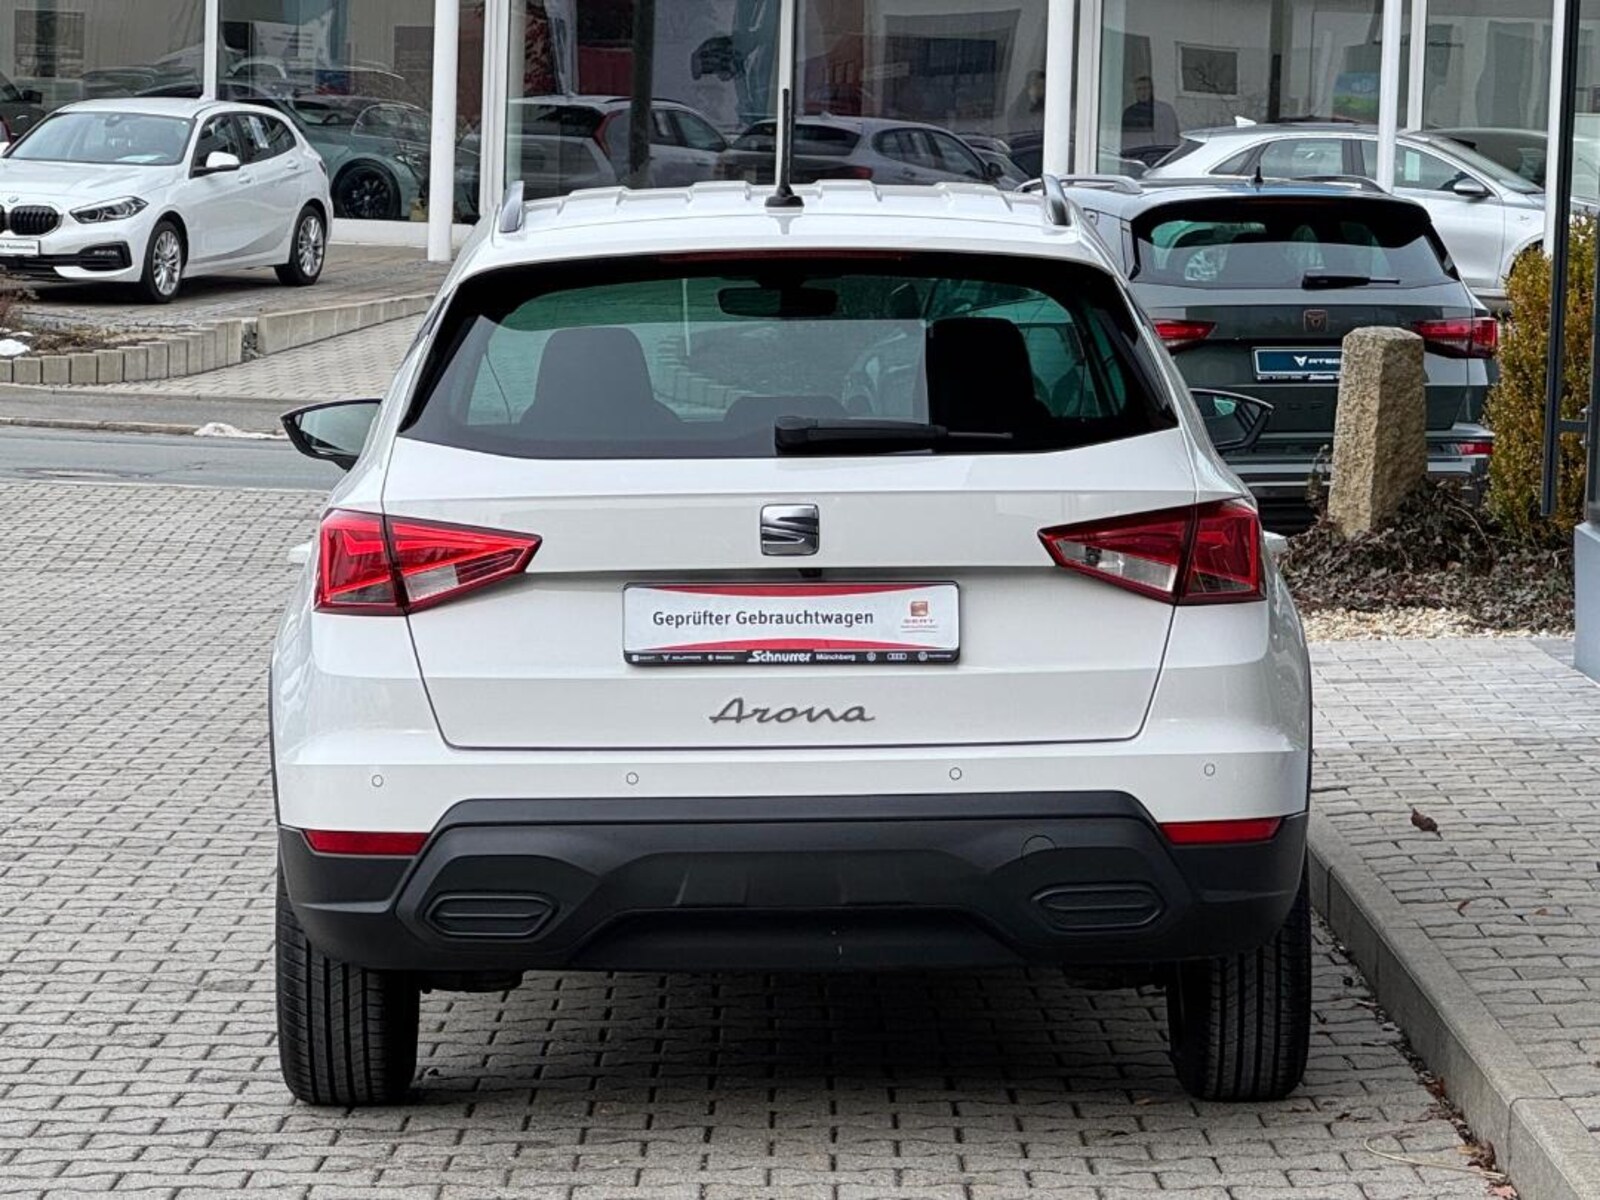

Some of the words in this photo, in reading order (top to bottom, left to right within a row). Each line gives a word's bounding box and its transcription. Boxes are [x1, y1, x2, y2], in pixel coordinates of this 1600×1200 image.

[653, 610, 731, 628] Geprüfter
[735, 610, 874, 627] Gebrauchtwagen
[747, 650, 811, 662] Schnurrer
[816, 652, 856, 661] Münchberg
[709, 697, 876, 723] Arona
